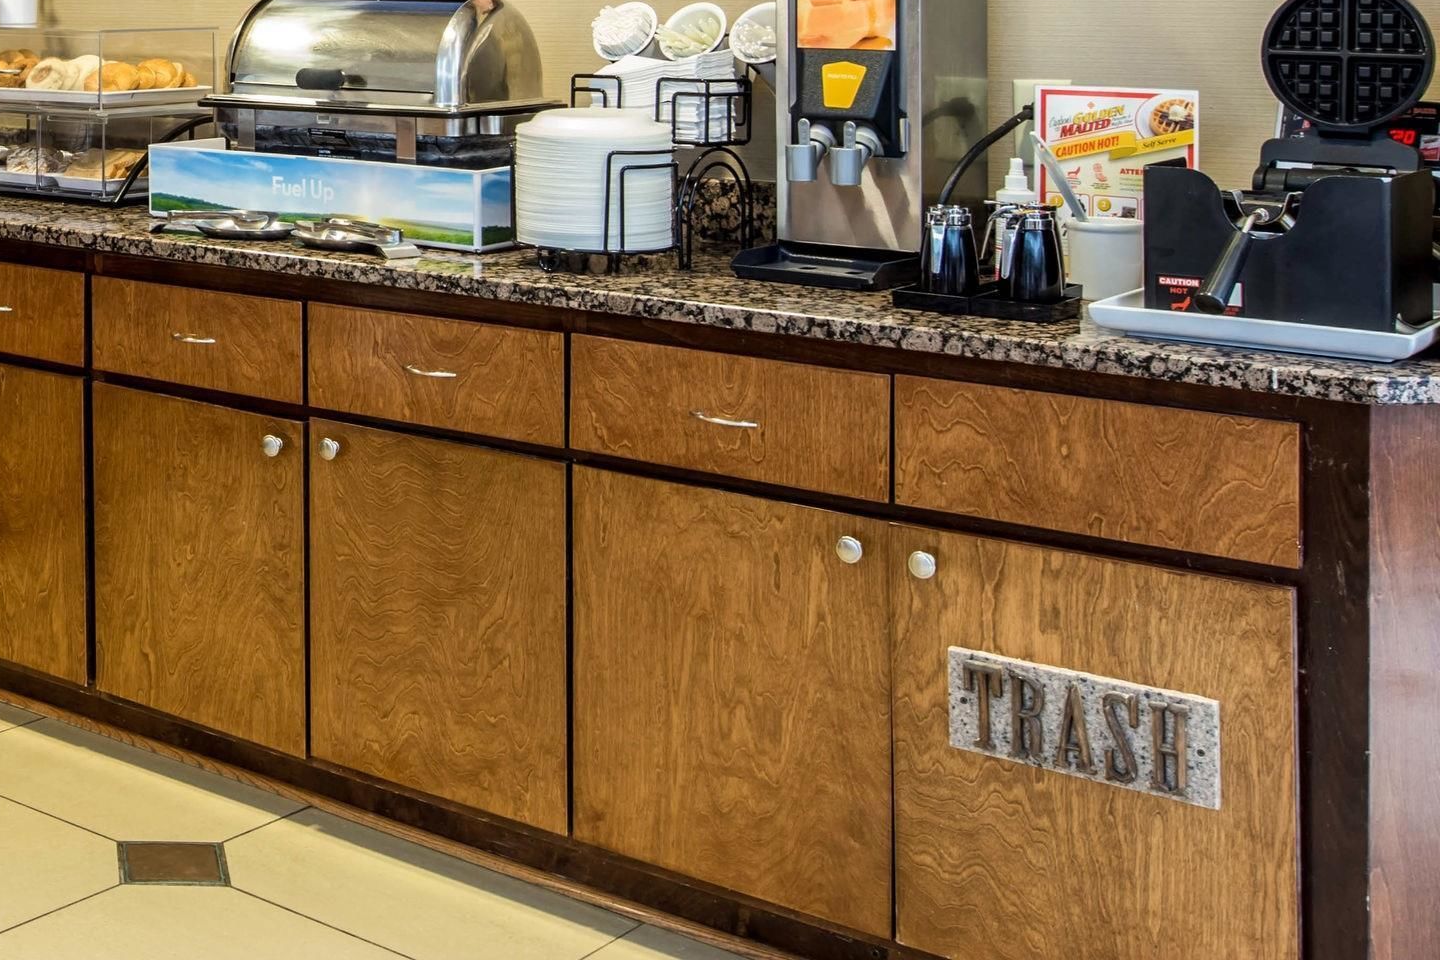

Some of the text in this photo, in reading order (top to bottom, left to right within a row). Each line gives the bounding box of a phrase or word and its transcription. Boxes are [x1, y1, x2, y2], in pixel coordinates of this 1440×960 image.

[1072, 104, 1125, 125] GOLDEN
[1059, 118, 1112, 138] MALTED
[1055, 135, 1120, 158] CAUTION HOT!
[271, 175, 335, 204] Fuel Up
[1159, 276, 1200, 287] CAUTION
[1169, 286, 1189, 295] HOT
[962, 654, 1190, 798] TRASH
